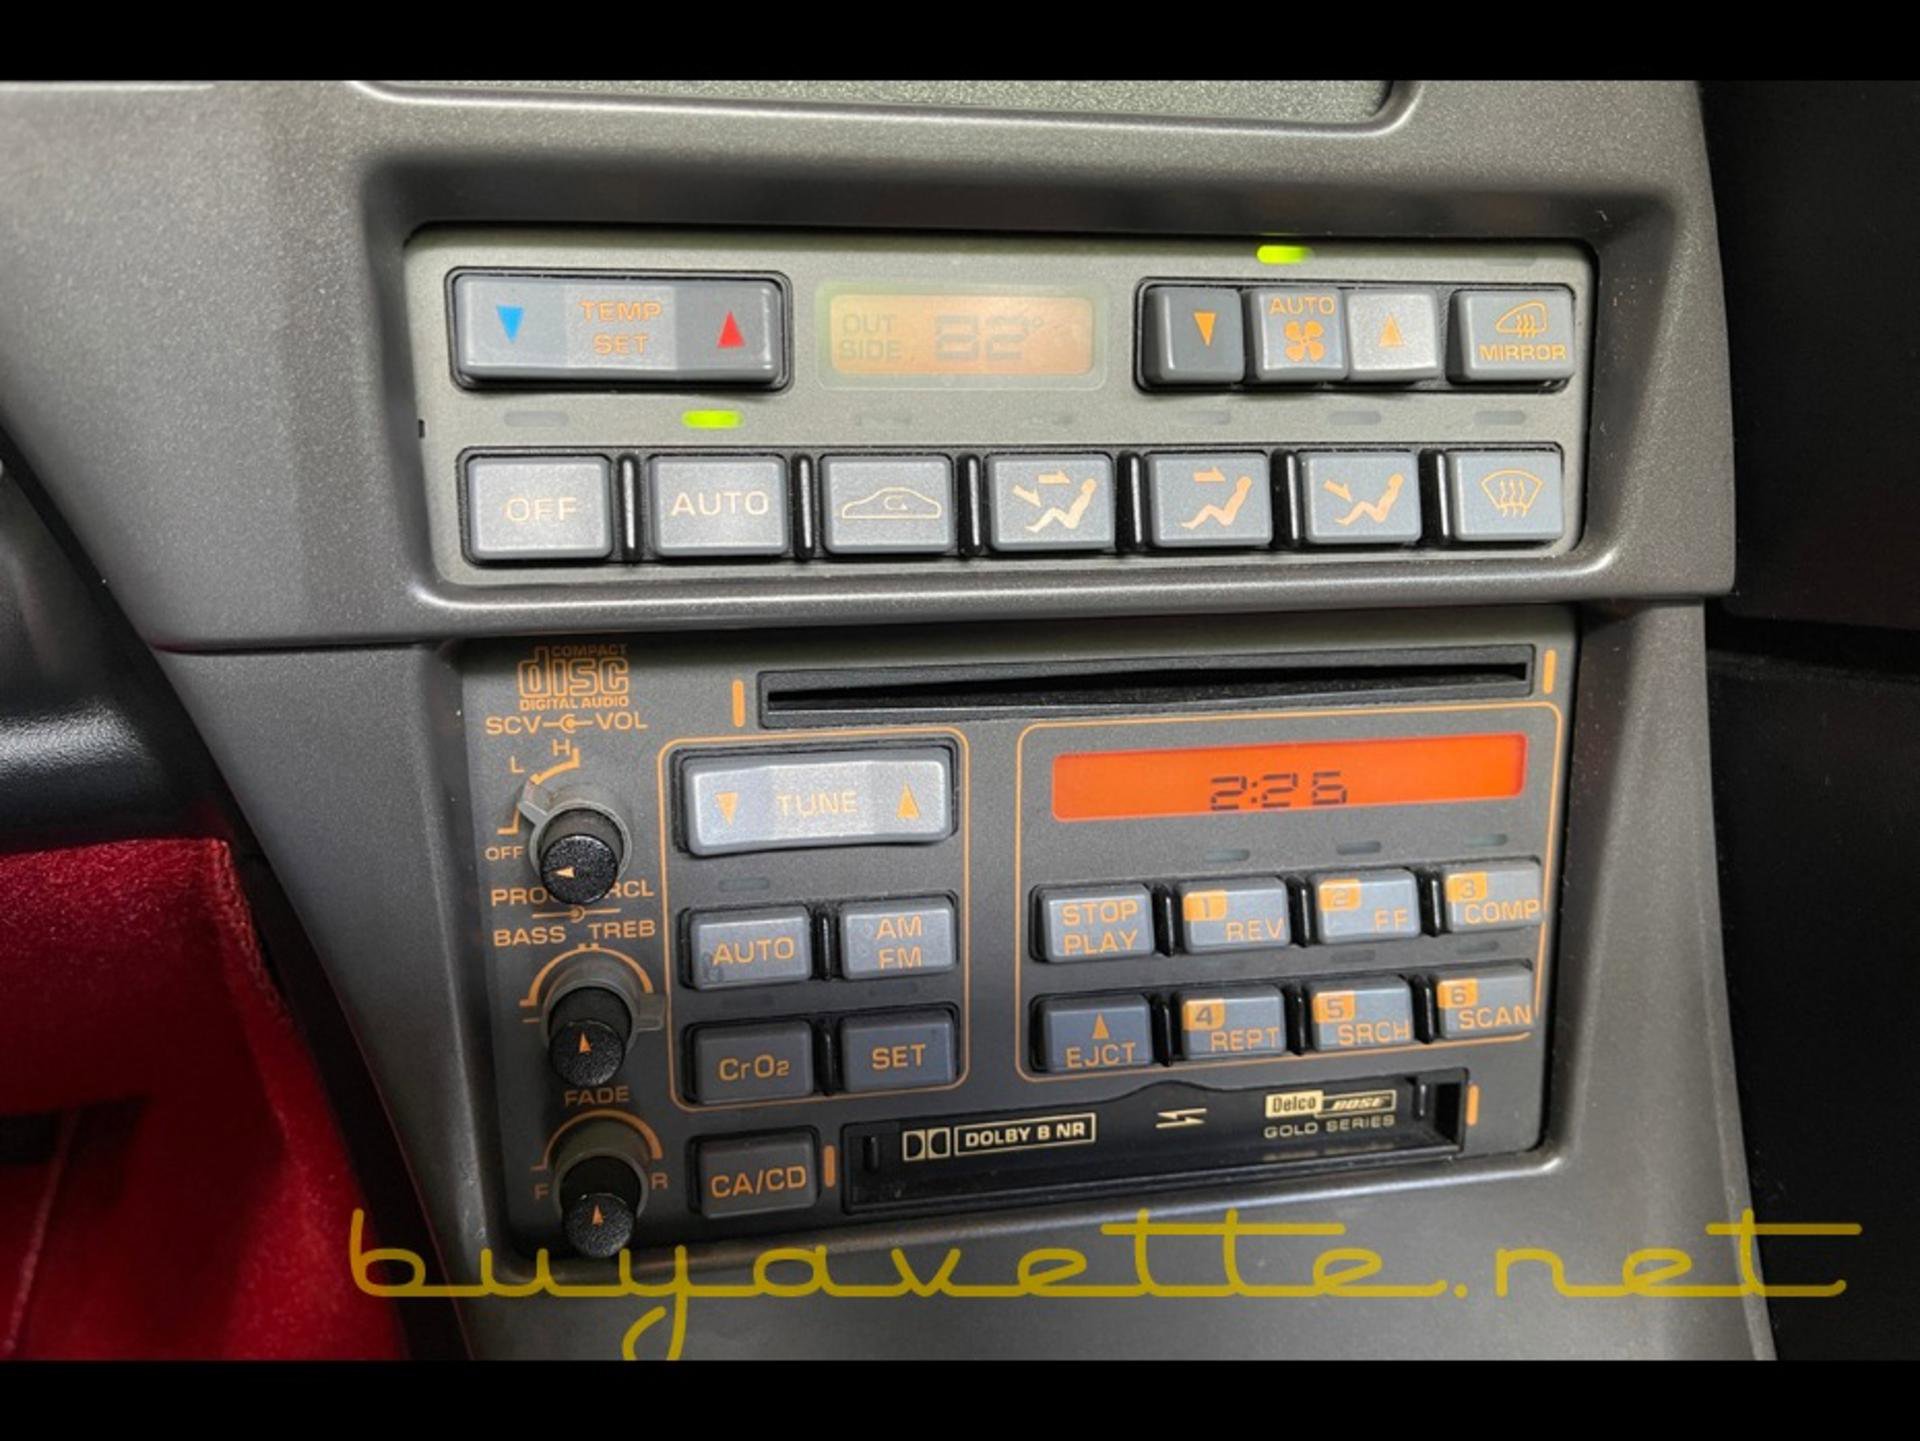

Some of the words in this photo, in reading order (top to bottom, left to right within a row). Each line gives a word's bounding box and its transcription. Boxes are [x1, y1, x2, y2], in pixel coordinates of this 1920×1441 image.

[580, 300, 663, 323] TEMP
[1269, 296, 1336, 314] AUTO
[842, 313, 897, 335] OUT
[593, 334, 649, 356] SET
[1479, 342, 1567, 362] MIRROR
[504, 497, 577, 523] OFF
[671, 491, 770, 517] AUTO
[551, 643, 628, 657] COMPACT
[519, 697, 578, 711] DIGITAL
[581, 695, 629, 708] AUDIO
[485, 715, 541, 735] SCV
[595, 711, 648, 730] VOL
[552, 739, 571, 756] H
[510, 755, 525, 773] L
[1209, 772, 1347, 811] 2:26
[777, 791, 857, 817] TUNE
[484, 846, 525, 861] OFF
[489, 886, 556, 907] PRO
[1329, 890, 1348, 908] 2
[1461, 880, 1477, 900] 3
[1062, 900, 1138, 927] STOP
[1375, 909, 1408, 929] FF
[1464, 900, 1541, 924] COMP
[492, 926, 567, 947] BASS
[588, 919, 656, 940] TREB
[875, 914, 923, 939] AM
[1226, 918, 1284, 943] REV
[712, 936, 796, 966] AUTO
[1063, 930, 1138, 956] PLAY
[878, 946, 923, 970] FM
[1450, 987, 1469, 1006] 6
[1196, 1006, 1215, 1025] 4
[1327, 1000, 1345, 1019] 5
[1458, 1005, 1533, 1031] SCAN
[1210, 1027, 1281, 1053] REPT
[1337, 1020, 1410, 1046] SRCH
[872, 1044, 926, 1070] SET
[1066, 1042, 1136, 1069] EJCT
[564, 1085, 630, 1107] FADE
[1272, 1097, 1317, 1114] Delco
[965, 1127, 1030, 1147] DOLBY
[1037, 1125, 1050, 1140] B
[1056, 1121, 1085, 1139] NR
[1264, 1121, 1319, 1139] GOLD
[1326, 1113, 1396, 1133] SERIES
[534, 1183, 549, 1201] F
[651, 1172, 669, 1190] R
[711, 1165, 807, 1198] CA/CD
